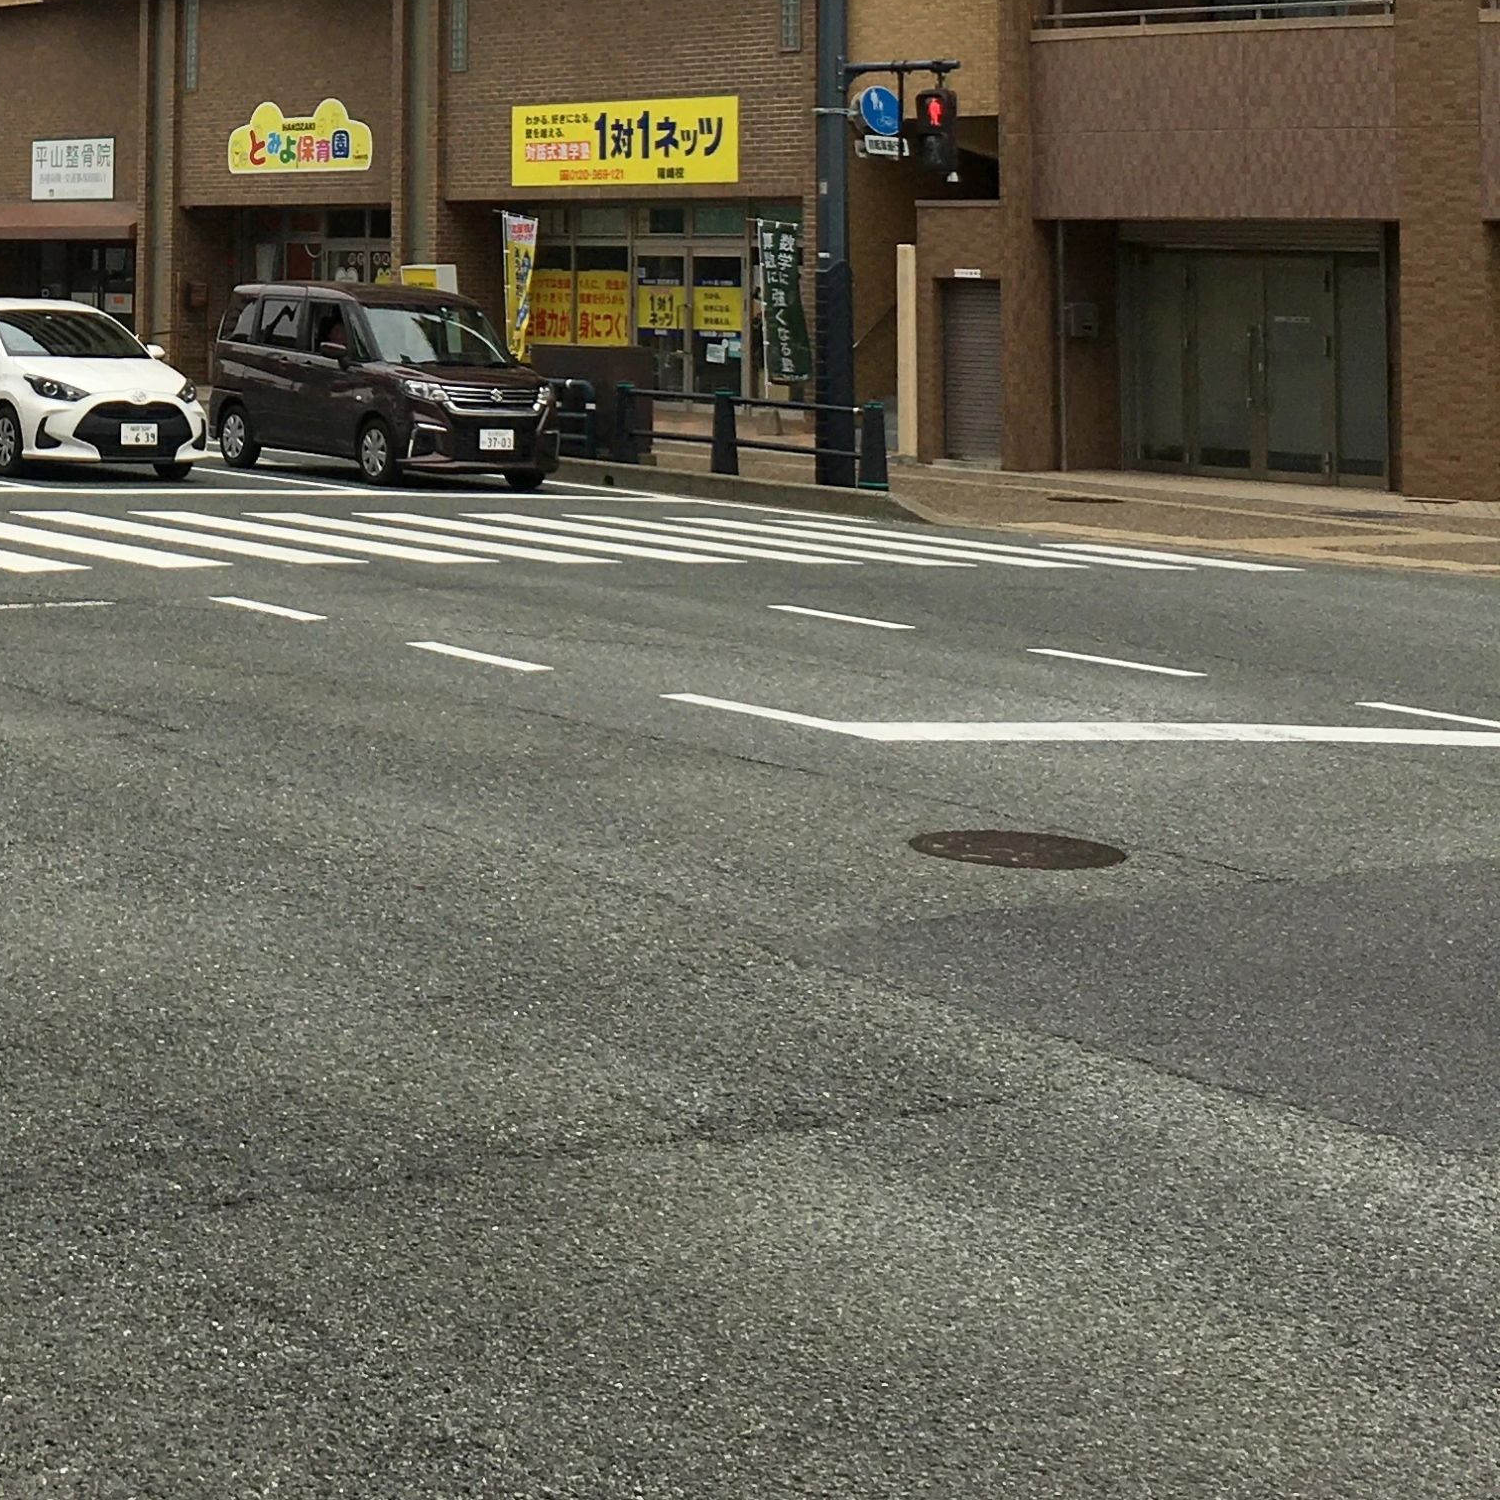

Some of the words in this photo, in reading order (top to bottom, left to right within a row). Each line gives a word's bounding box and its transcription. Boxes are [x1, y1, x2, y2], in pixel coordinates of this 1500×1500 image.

[282, 122, 316, 132] HAKOZAKI
[594, 110, 723, 161] 1対1ネッツ
[35, 143, 111, 169] 平山整骨院
[249, 128, 349, 166] とみよ保育園
